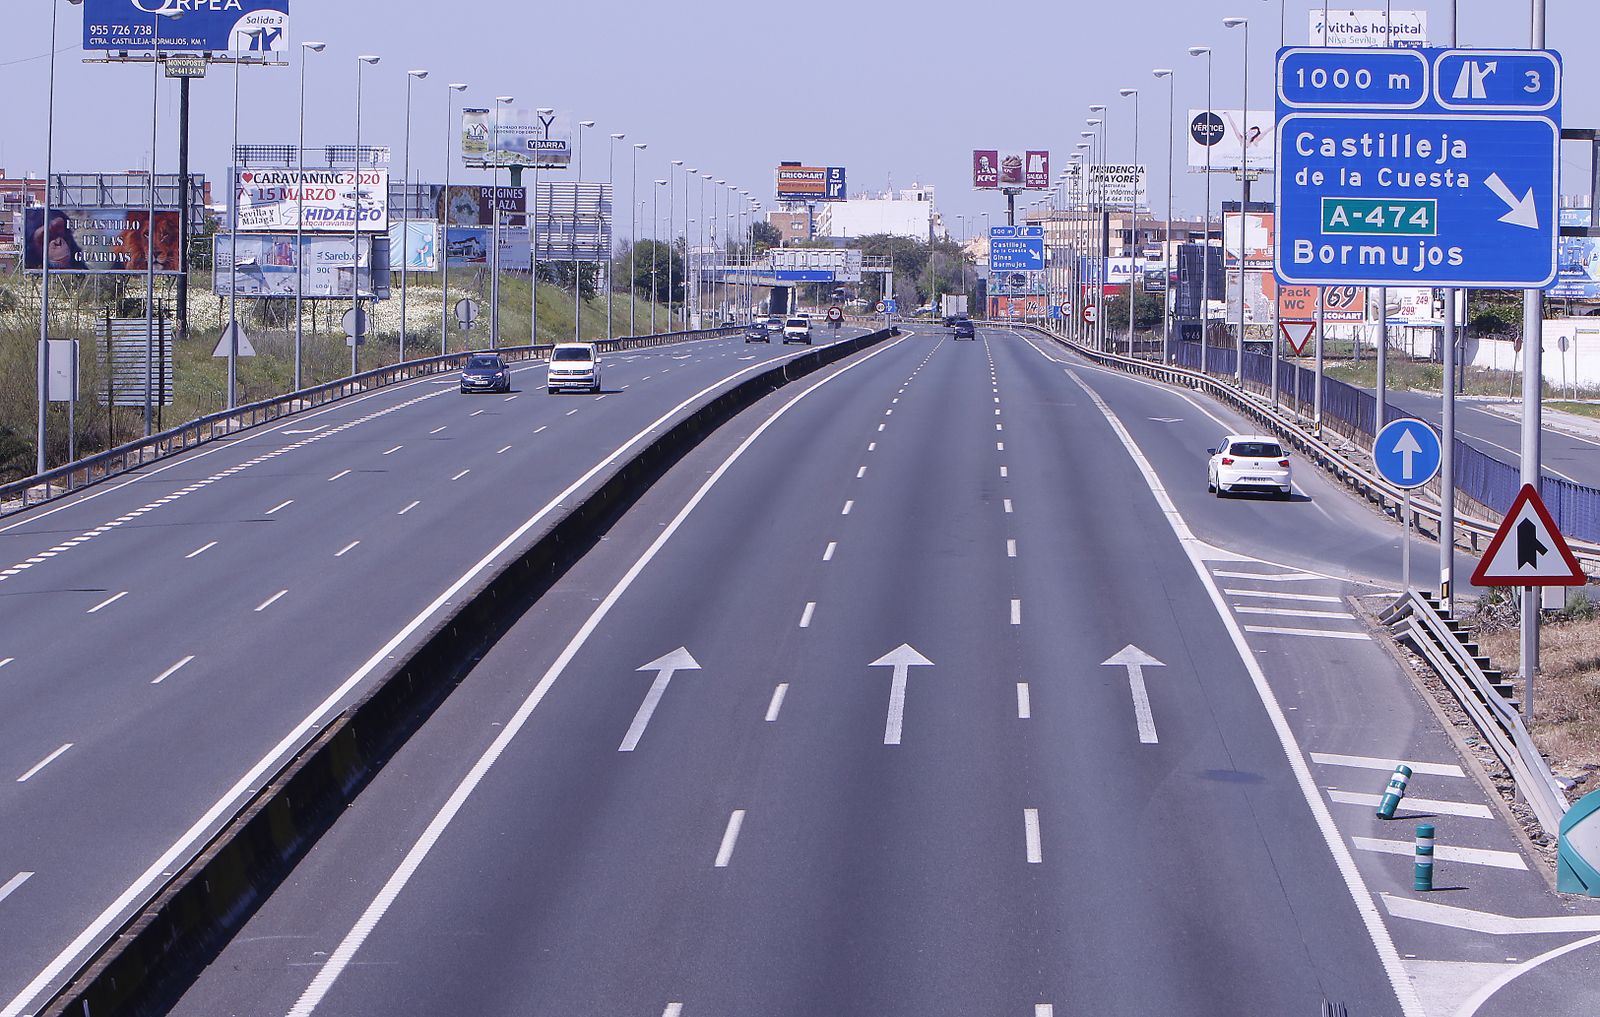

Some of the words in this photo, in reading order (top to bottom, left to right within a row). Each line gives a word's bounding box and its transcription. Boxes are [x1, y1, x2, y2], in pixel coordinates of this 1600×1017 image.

[246, 15, 274, 24] Salida
[277, 16, 283, 24] 3
[90, 25, 108, 35] 955
[112, 25, 131, 35] 726
[134, 25, 151, 35] 738
[1328, 22, 1368, 34] vithas
[1371, 23, 1421, 36] hospital
[1327, 35, 1347, 44] Nisa
[1349, 36, 1377, 44] Sevilla
[1296, 68, 1372, 90] 1000
[1388, 73, 1411, 90] m
[1523, 71, 1542, 93] 3
[529, 141, 564, 149] YBARRA
[1295, 132, 1468, 165] Castilleja
[831, 169, 840, 179] 5
[1090, 165, 1145, 174] RESIDENCIA
[253, 173, 344, 184] CARAVANING
[346, 173, 380, 185] 2020
[976, 174, 997, 182] KFC
[1094, 174, 1140, 183] MAYORES
[1295, 168, 1324, 187] de
[1340, 168, 1362, 187] la
[1377, 168, 1469, 188] Cuesta
[257, 187, 276, 200] 15
[279, 187, 336, 201] MARZO
[496, 188, 524, 199] GINES
[488, 199, 517, 210] PAZA
[238, 208, 267, 218] Sevilla
[305, 208, 382, 222] HIDALGO
[1328, 206, 1430, 229] A-474
[82, 219, 141, 230] CASTILLO
[242, 215, 275, 226] Málaga
[83, 234, 99, 246] DE
[103, 234, 124, 246] LAS
[74, 251, 131, 262] GUARDAS
[1293, 239, 1464, 272] Bormujos
[993, 261, 1027, 269] Bormujos
[1111, 264, 1144, 274] ALDI
[1280, 287, 1311, 297] Pack
[1284, 299, 1305, 310] WC
[1313, 312, 1362, 320] BICOMART
